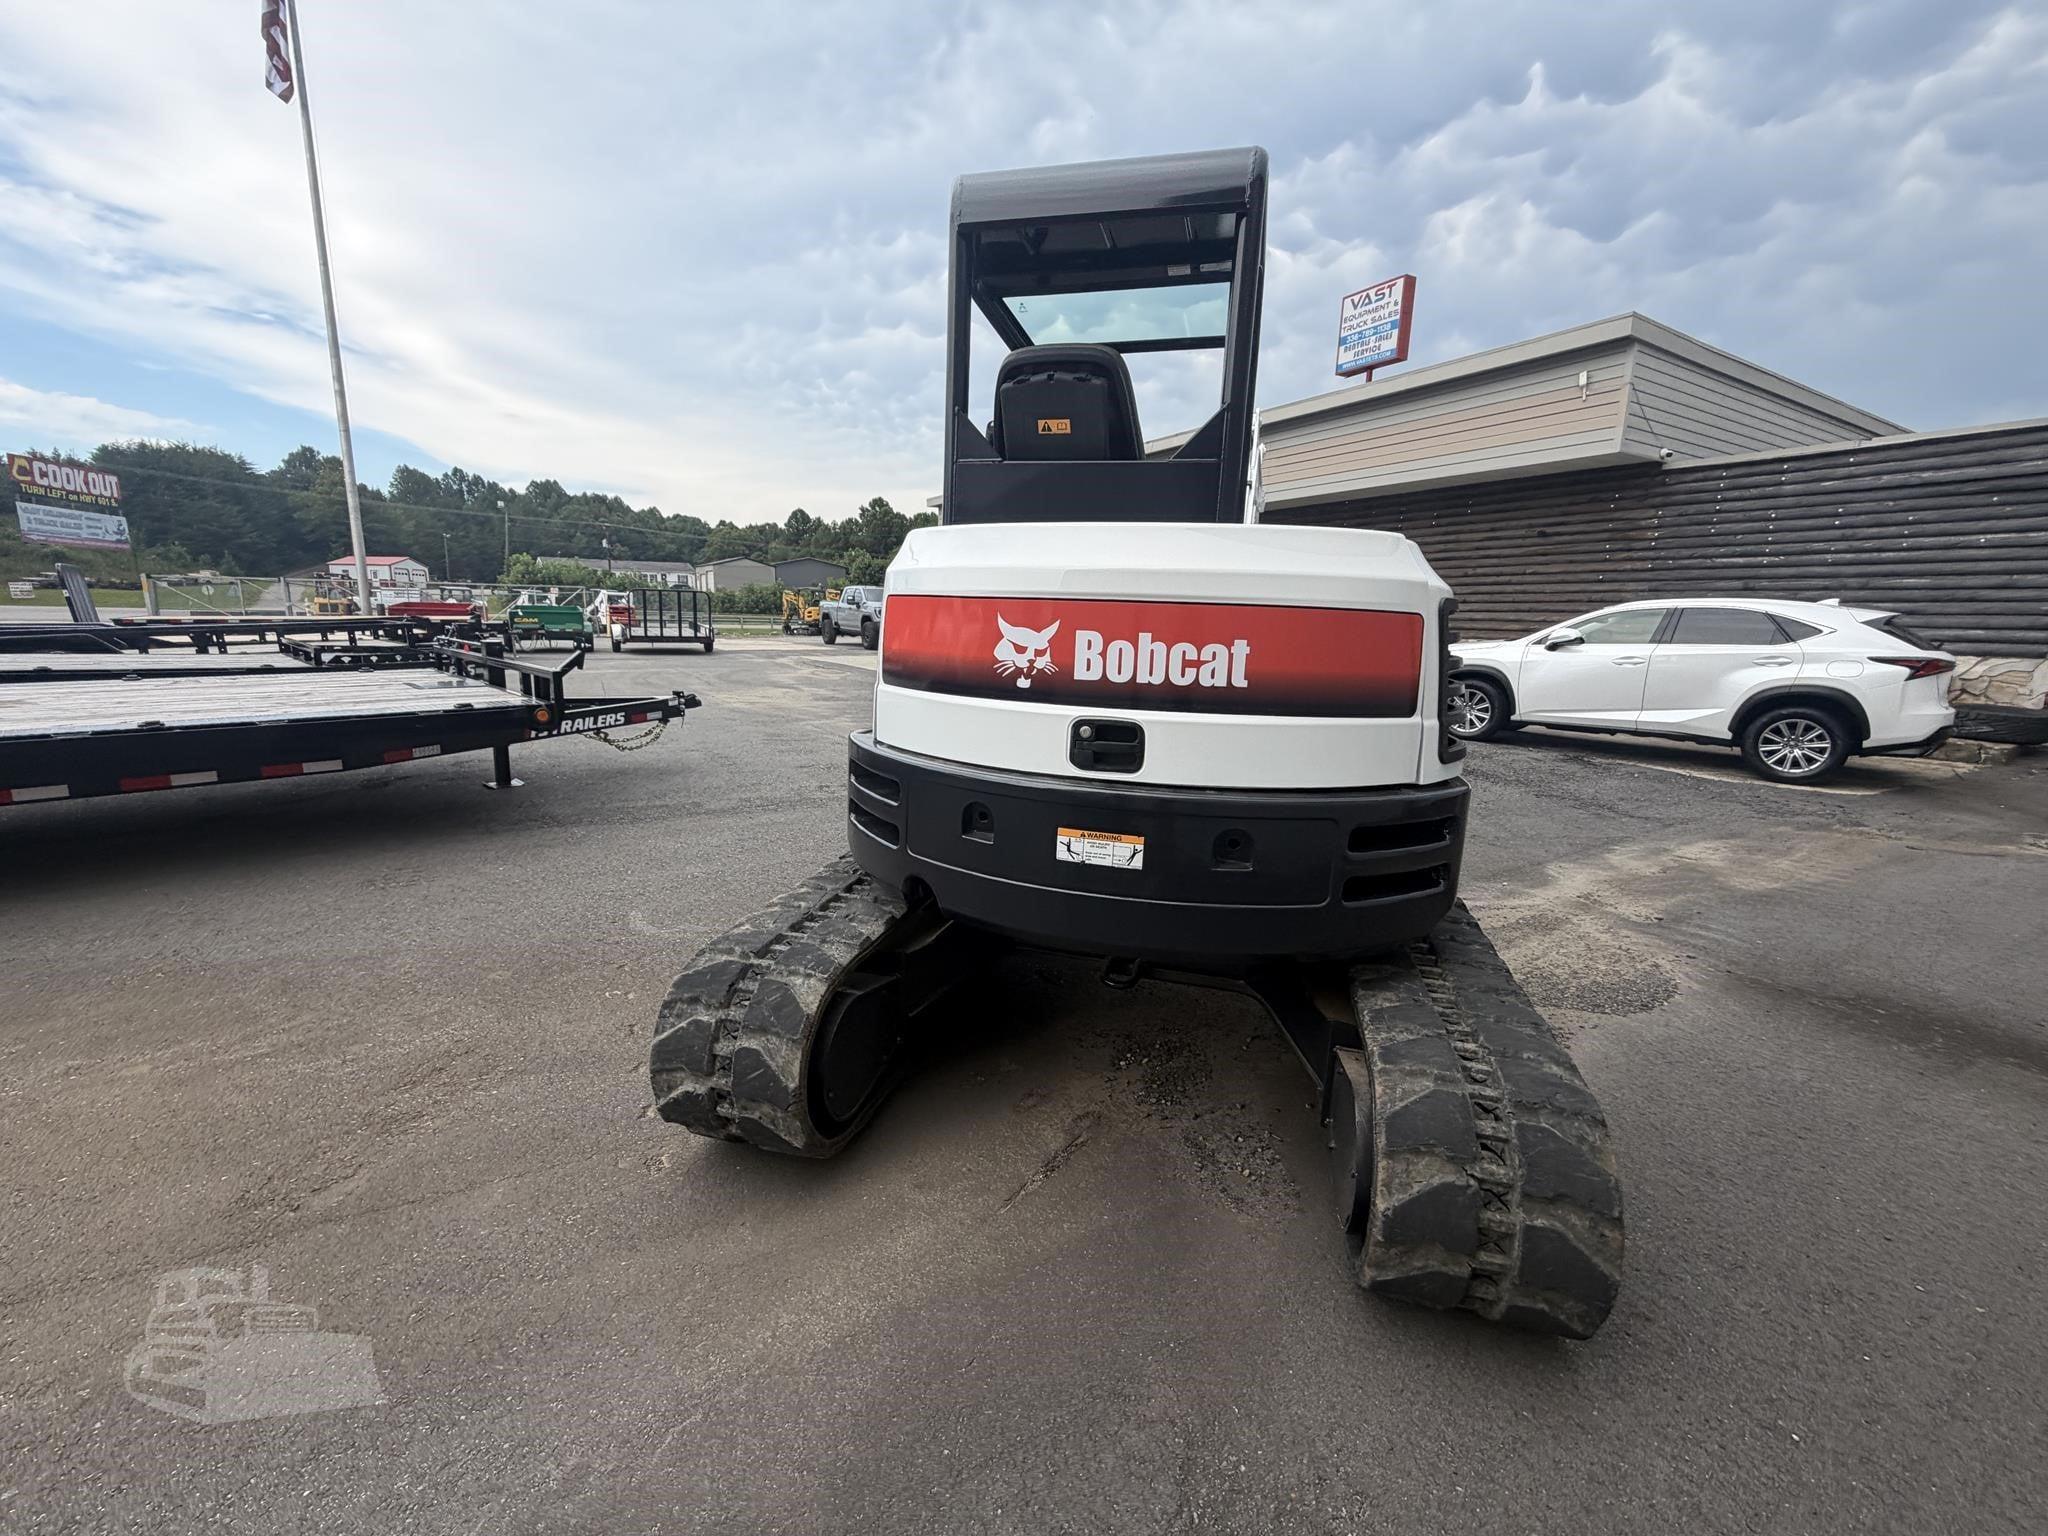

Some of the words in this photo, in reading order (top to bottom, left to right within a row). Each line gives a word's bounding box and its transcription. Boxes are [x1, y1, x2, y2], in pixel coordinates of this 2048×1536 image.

[1350, 282, 1398, 310] VAST
[1342, 319, 1368, 333] TRUCK
[1370, 309, 1400, 324] SALES
[1343, 301, 1391, 324] EQUIPMENT
[1393, 299, 1399, 307] &
[1353, 344, 1382, 358] SERVICE
[20, 484, 45, 496] TURN
[47, 489, 67, 499] LEFT
[80, 494, 95, 504] HWY
[1074, 630, 1250, 688] Bobcat
[1087, 832, 1122, 841] WARNING
